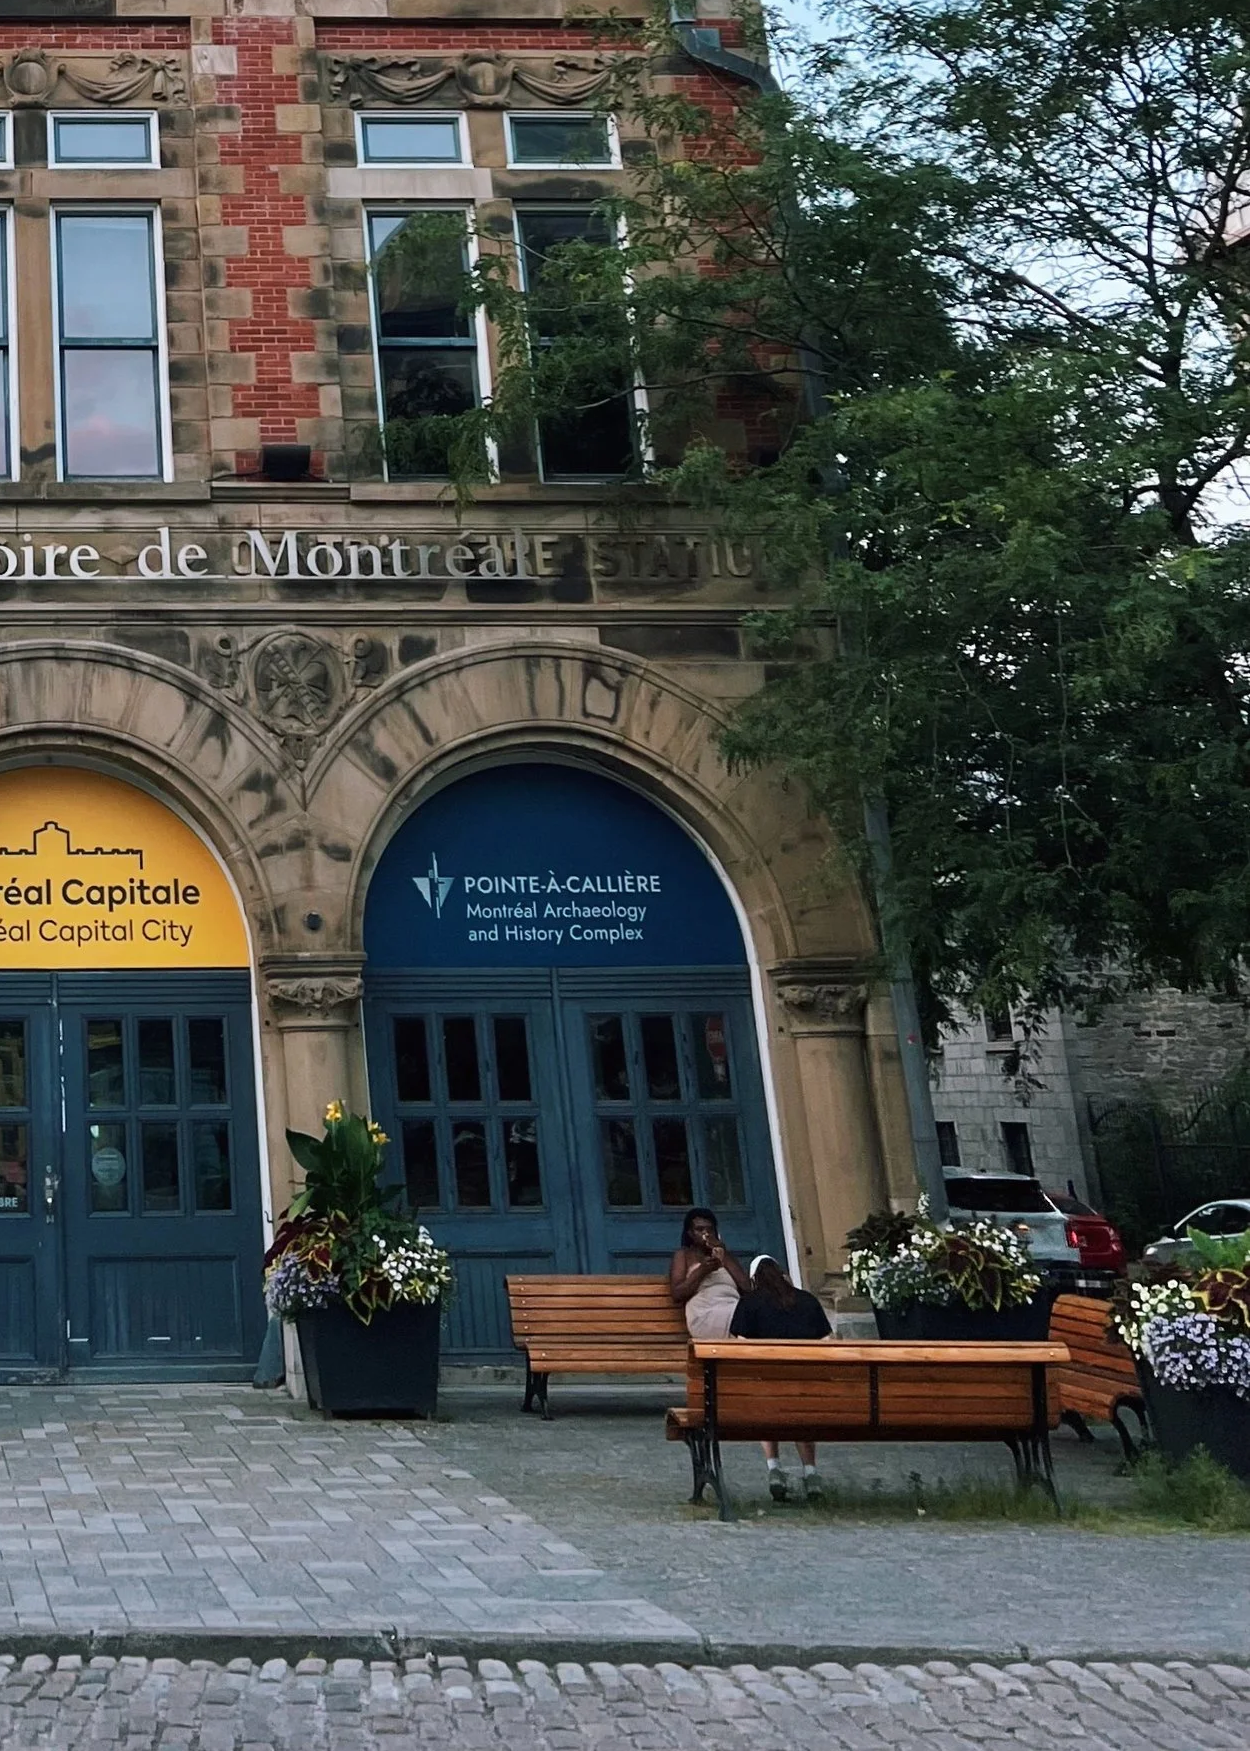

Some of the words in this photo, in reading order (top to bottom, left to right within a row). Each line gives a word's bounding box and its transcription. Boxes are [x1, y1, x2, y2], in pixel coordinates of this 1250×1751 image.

[137, 526, 209, 579] de
[244, 526, 530, 579] Montréal
[463, 870, 662, 893] POINTE-À-CALLIÈRE
[61, 877, 201, 913] Capitale
[466, 901, 537, 919] Montréal
[543, 901, 647, 921] Archaeology
[38, 919, 134, 948] Capital
[141, 919, 193, 948] City
[468, 924, 499, 941] and
[505, 925, 564, 945] History
[569, 923, 644, 945] Complex
